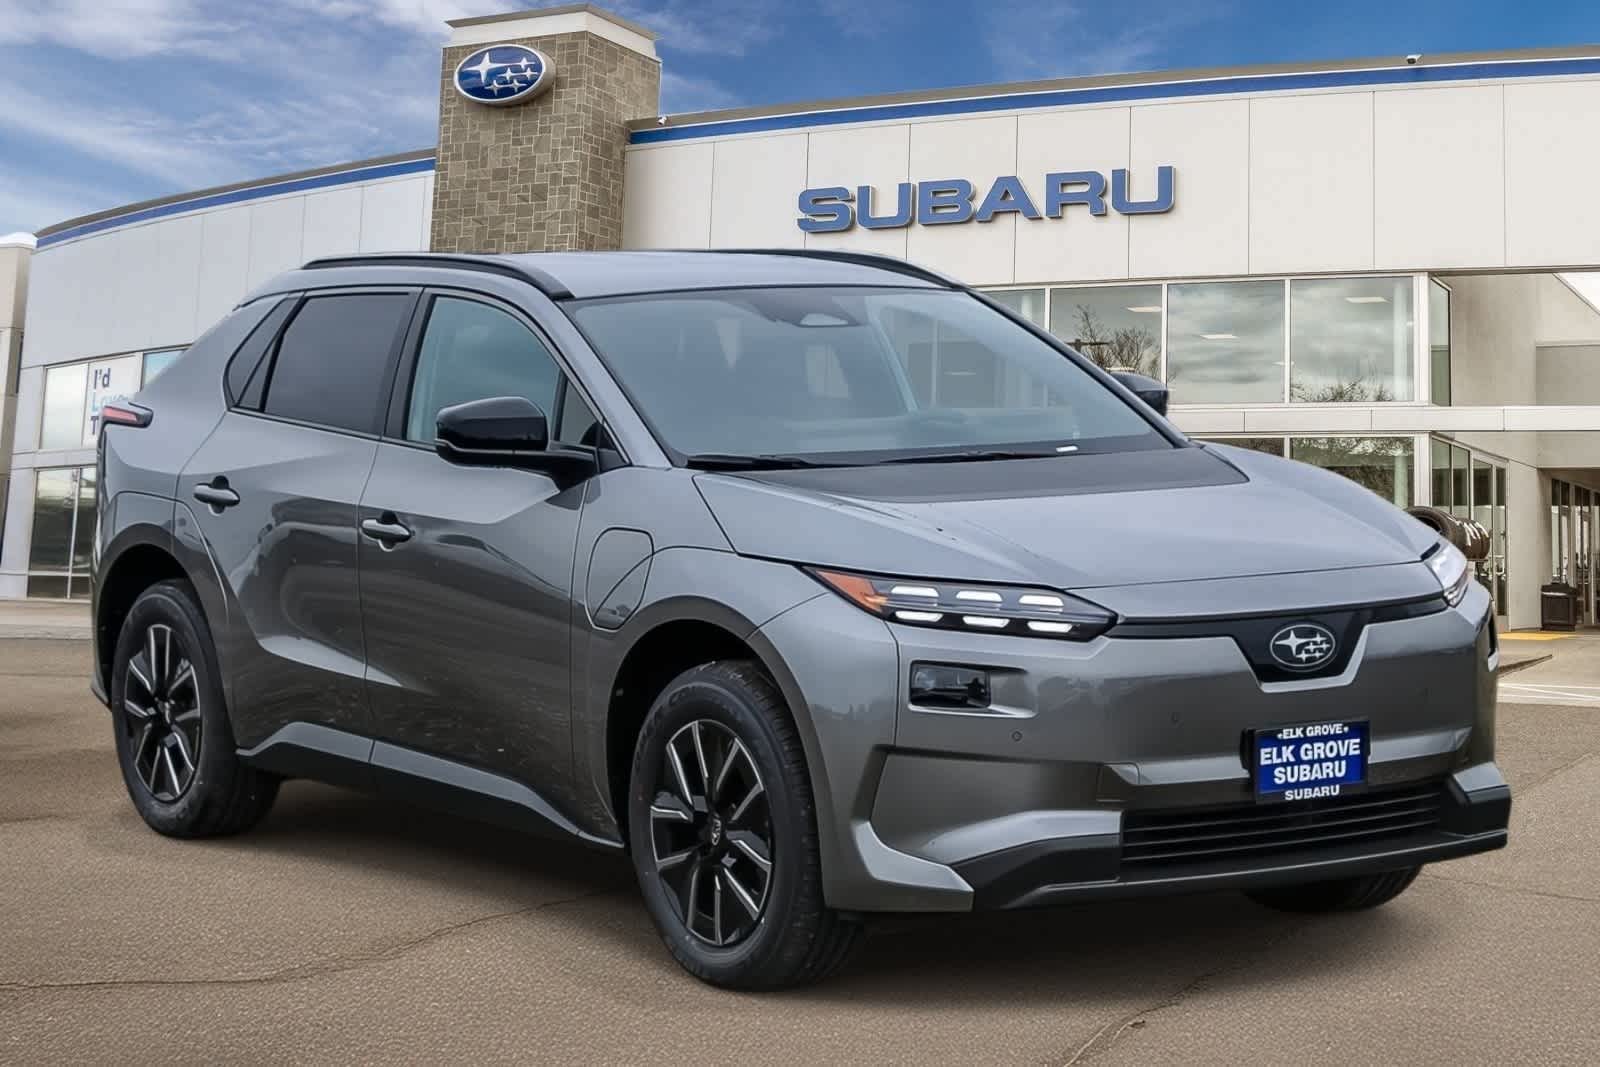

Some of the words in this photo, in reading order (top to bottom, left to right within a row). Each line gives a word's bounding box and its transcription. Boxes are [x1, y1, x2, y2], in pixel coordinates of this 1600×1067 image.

[797, 165, 1177, 233] SUBARU
[1283, 727, 1304, 739] ELK
[1306, 723, 1343, 737] GROVE
[1260, 745, 1295, 765] ELK
[1300, 739, 1360, 760] GROVE
[1274, 760, 1346, 784] SUBARU
[1285, 785, 1340, 800] SUBARU
